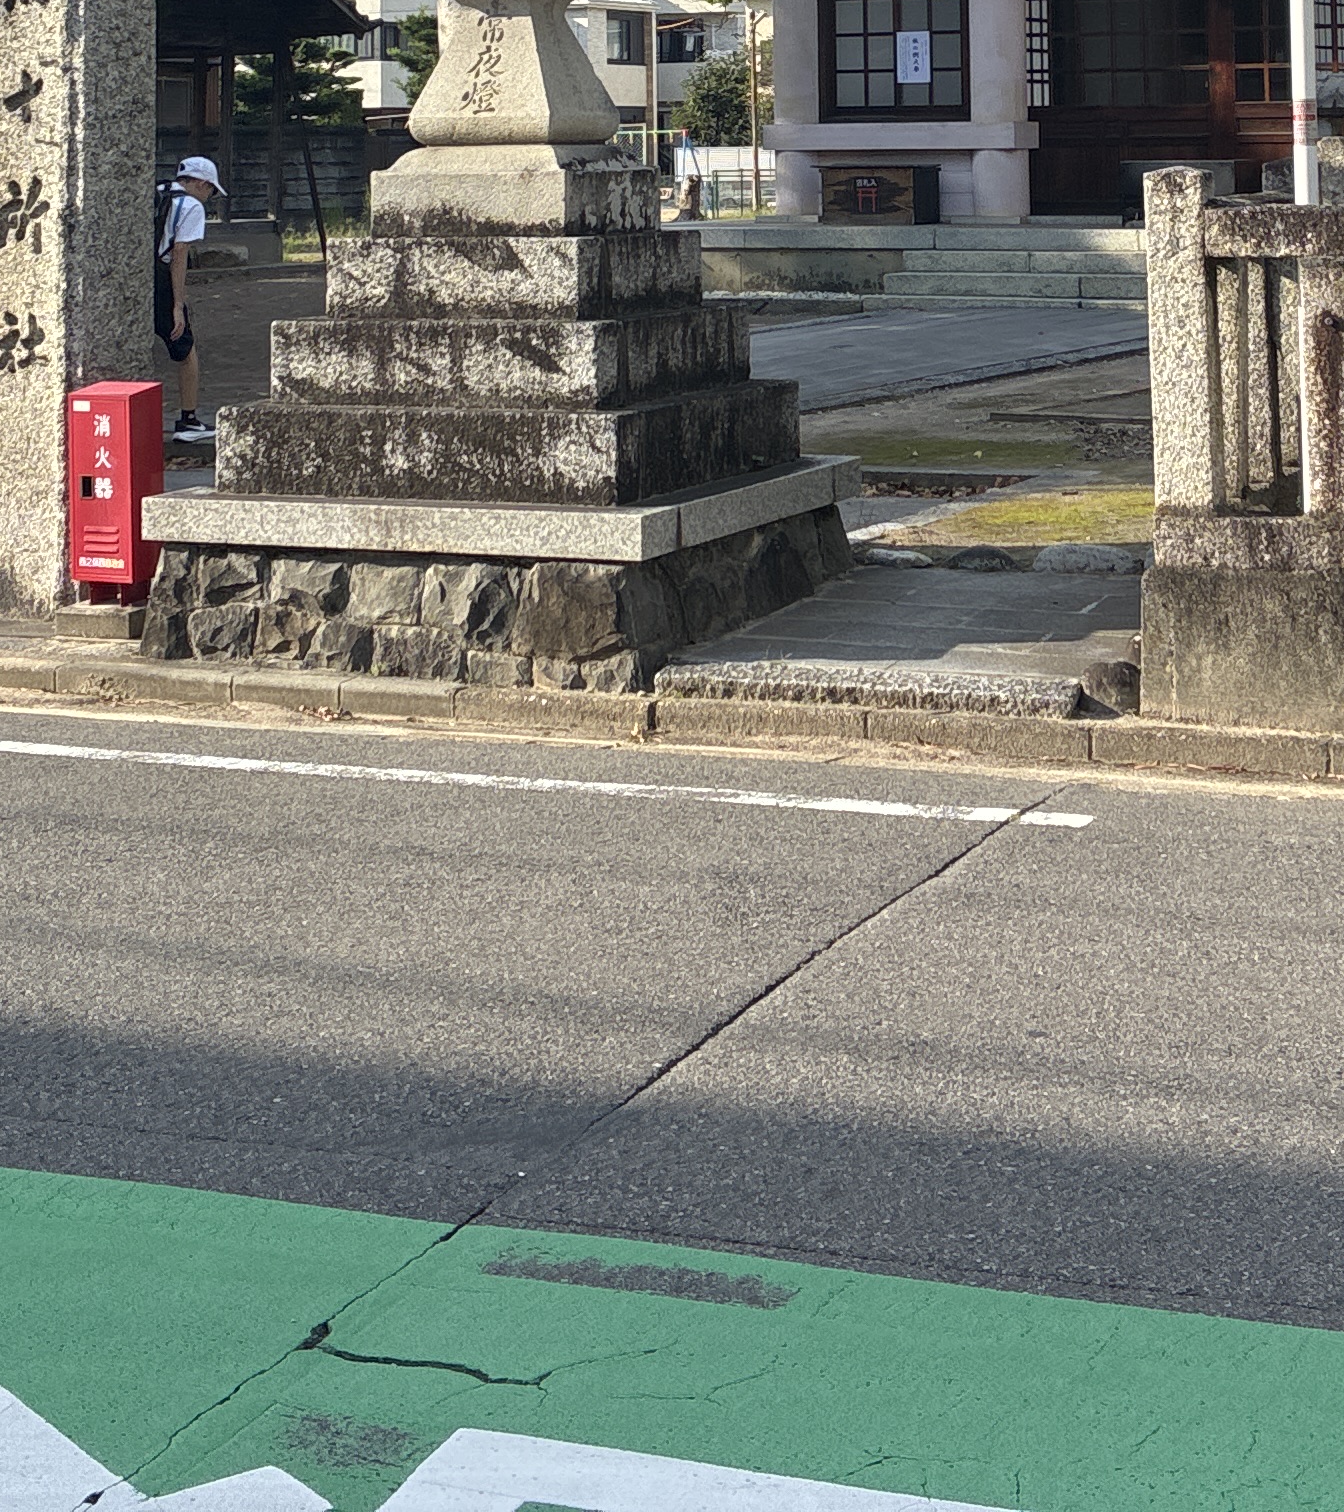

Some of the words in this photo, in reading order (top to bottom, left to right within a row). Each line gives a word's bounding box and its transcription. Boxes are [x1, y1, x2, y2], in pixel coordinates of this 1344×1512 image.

[459, 0, 512, 115] 常夜燈
[93, 414, 113, 499] 消火器
